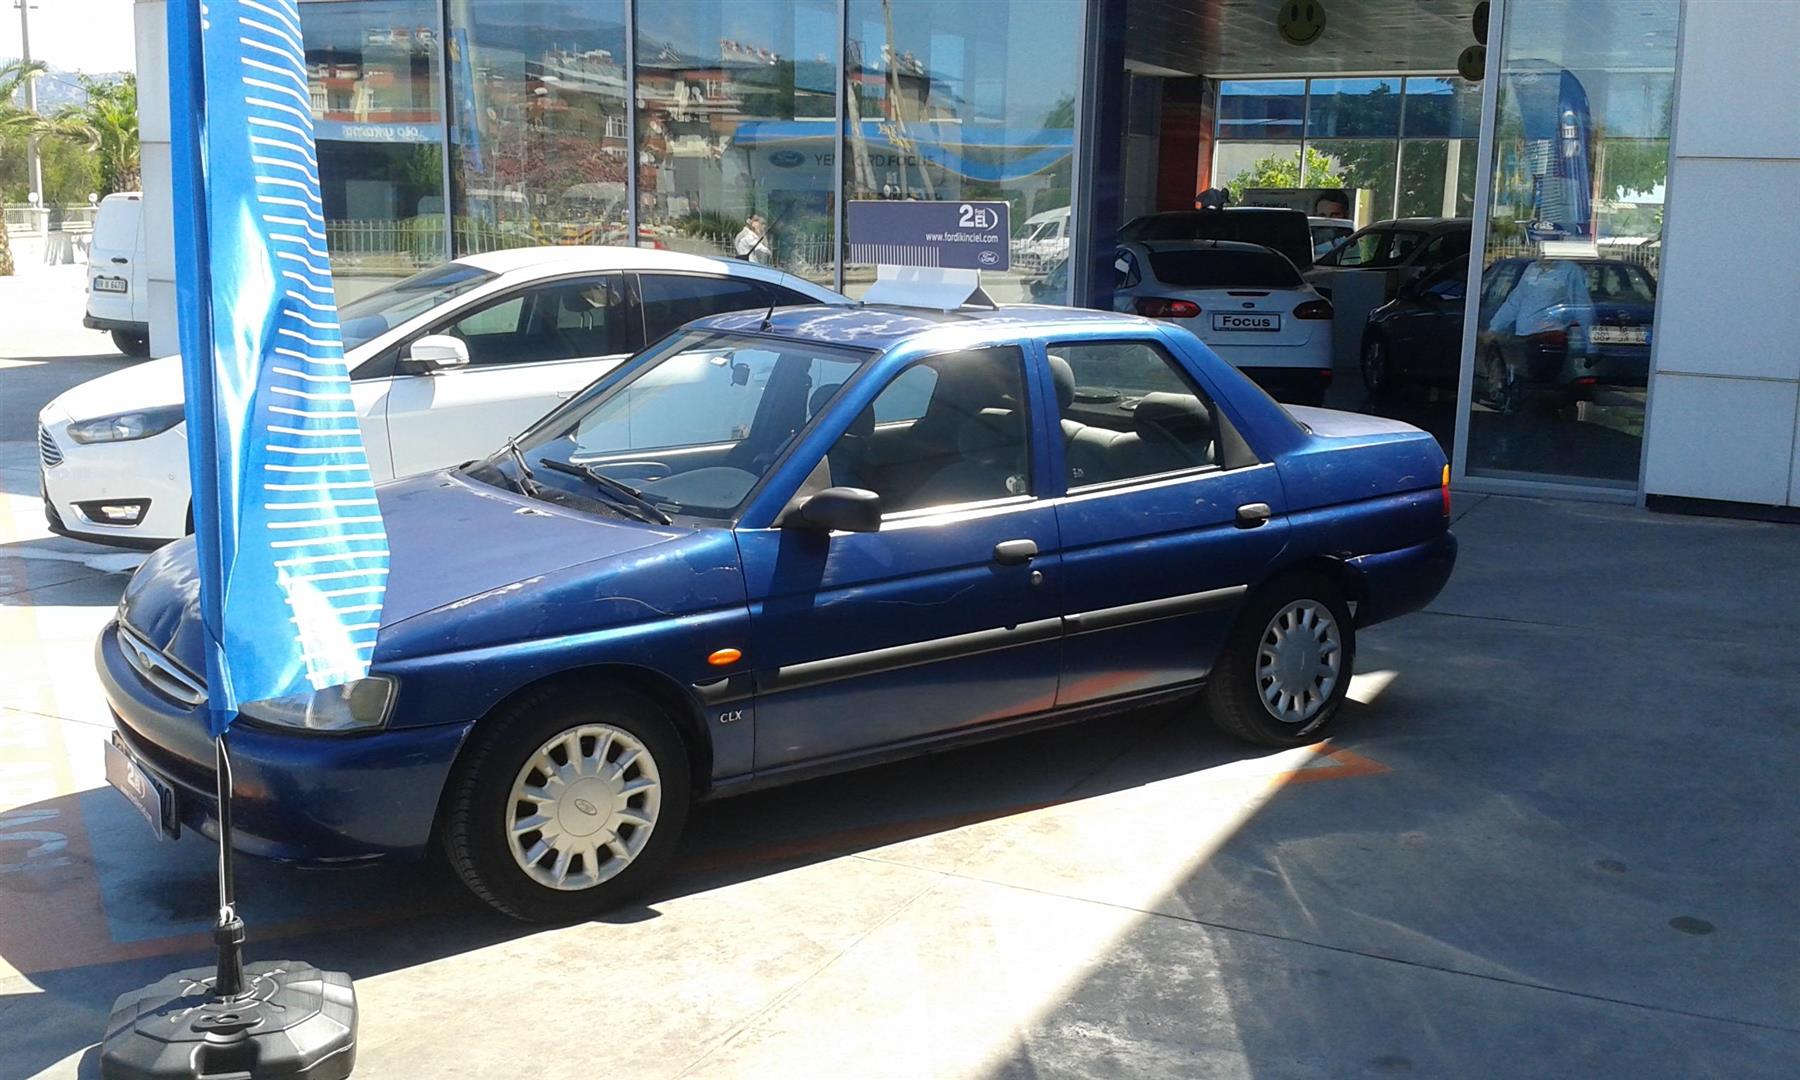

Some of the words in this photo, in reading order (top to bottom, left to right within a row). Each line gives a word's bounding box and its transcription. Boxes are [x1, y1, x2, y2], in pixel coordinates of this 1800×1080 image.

[925, 232, 999, 243] www.fordikinciel.com
[1222, 316, 1270, 327] Focus
[720, 710, 742, 723] CLX
